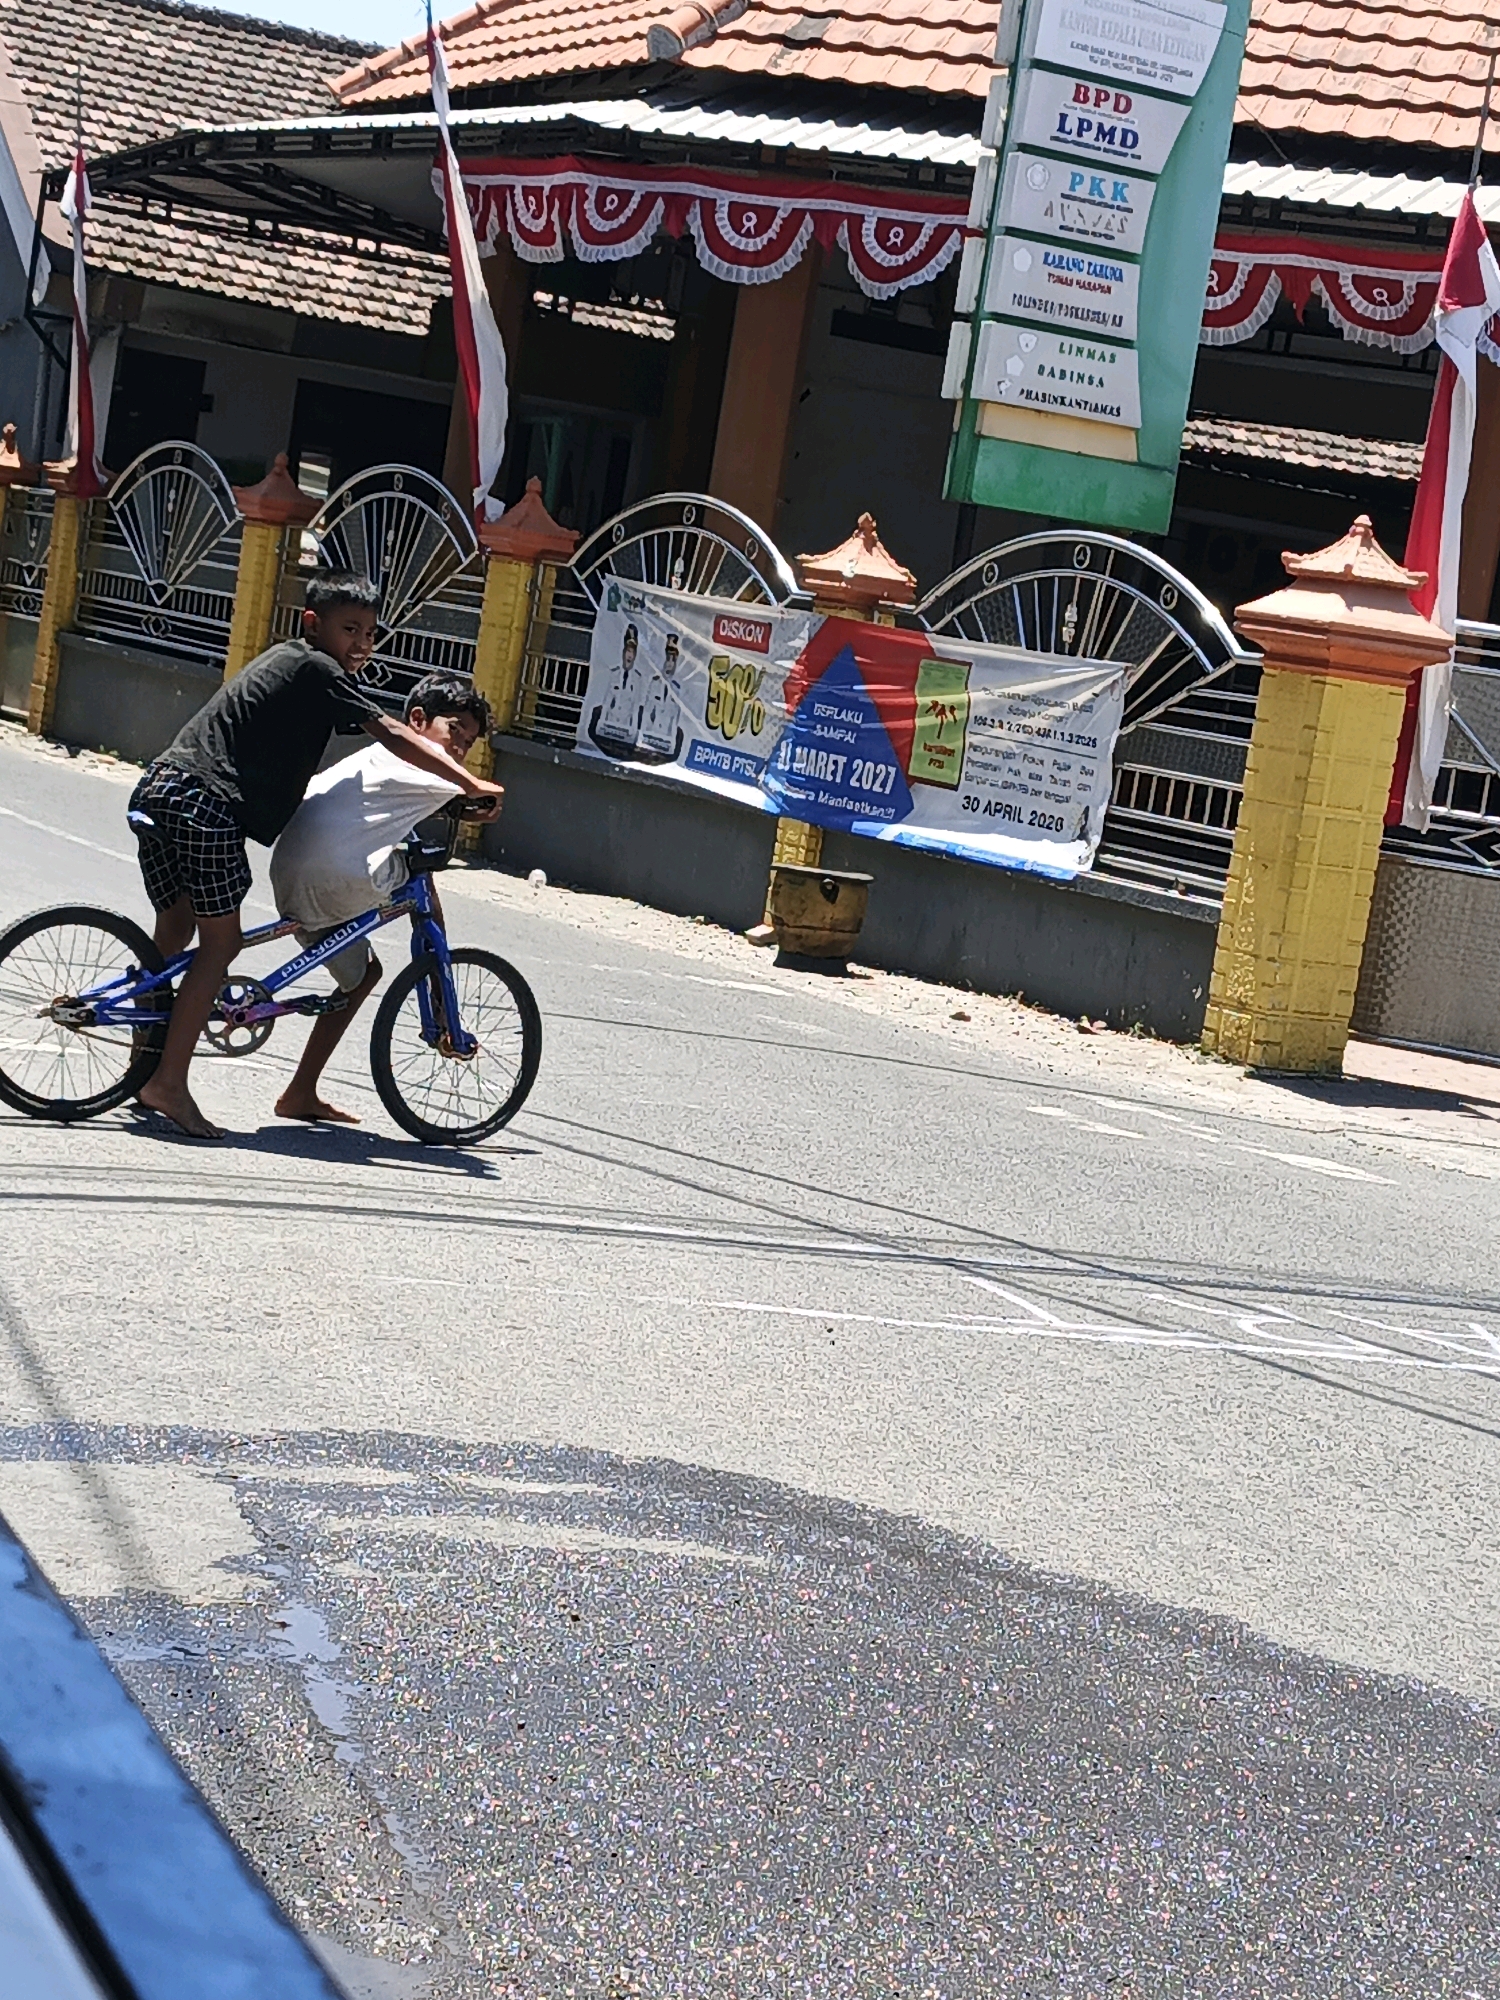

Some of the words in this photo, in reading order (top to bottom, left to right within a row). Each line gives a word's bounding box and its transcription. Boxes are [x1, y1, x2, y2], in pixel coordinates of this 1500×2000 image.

[1072, 82, 1132, 114] BPD
[1056, 112, 1139, 149] LPMD
[1068, 171, 1130, 203] PKK
[1059, 342, 1116, 364] LINMAS
[1037, 364, 1104, 388] BABINSA
[719, 618, 765, 644] DISKON
[705, 655, 767, 741] 50%
[694, 745, 731, 770] BPHTB
[732, 755, 757, 777] PTSL
[793, 746, 848, 783] MARET
[849, 759, 897, 805] 2027
[962, 795, 981, 813] 30
[982, 799, 1024, 824] APRIL
[281, 921, 360, 978] POLYGON
